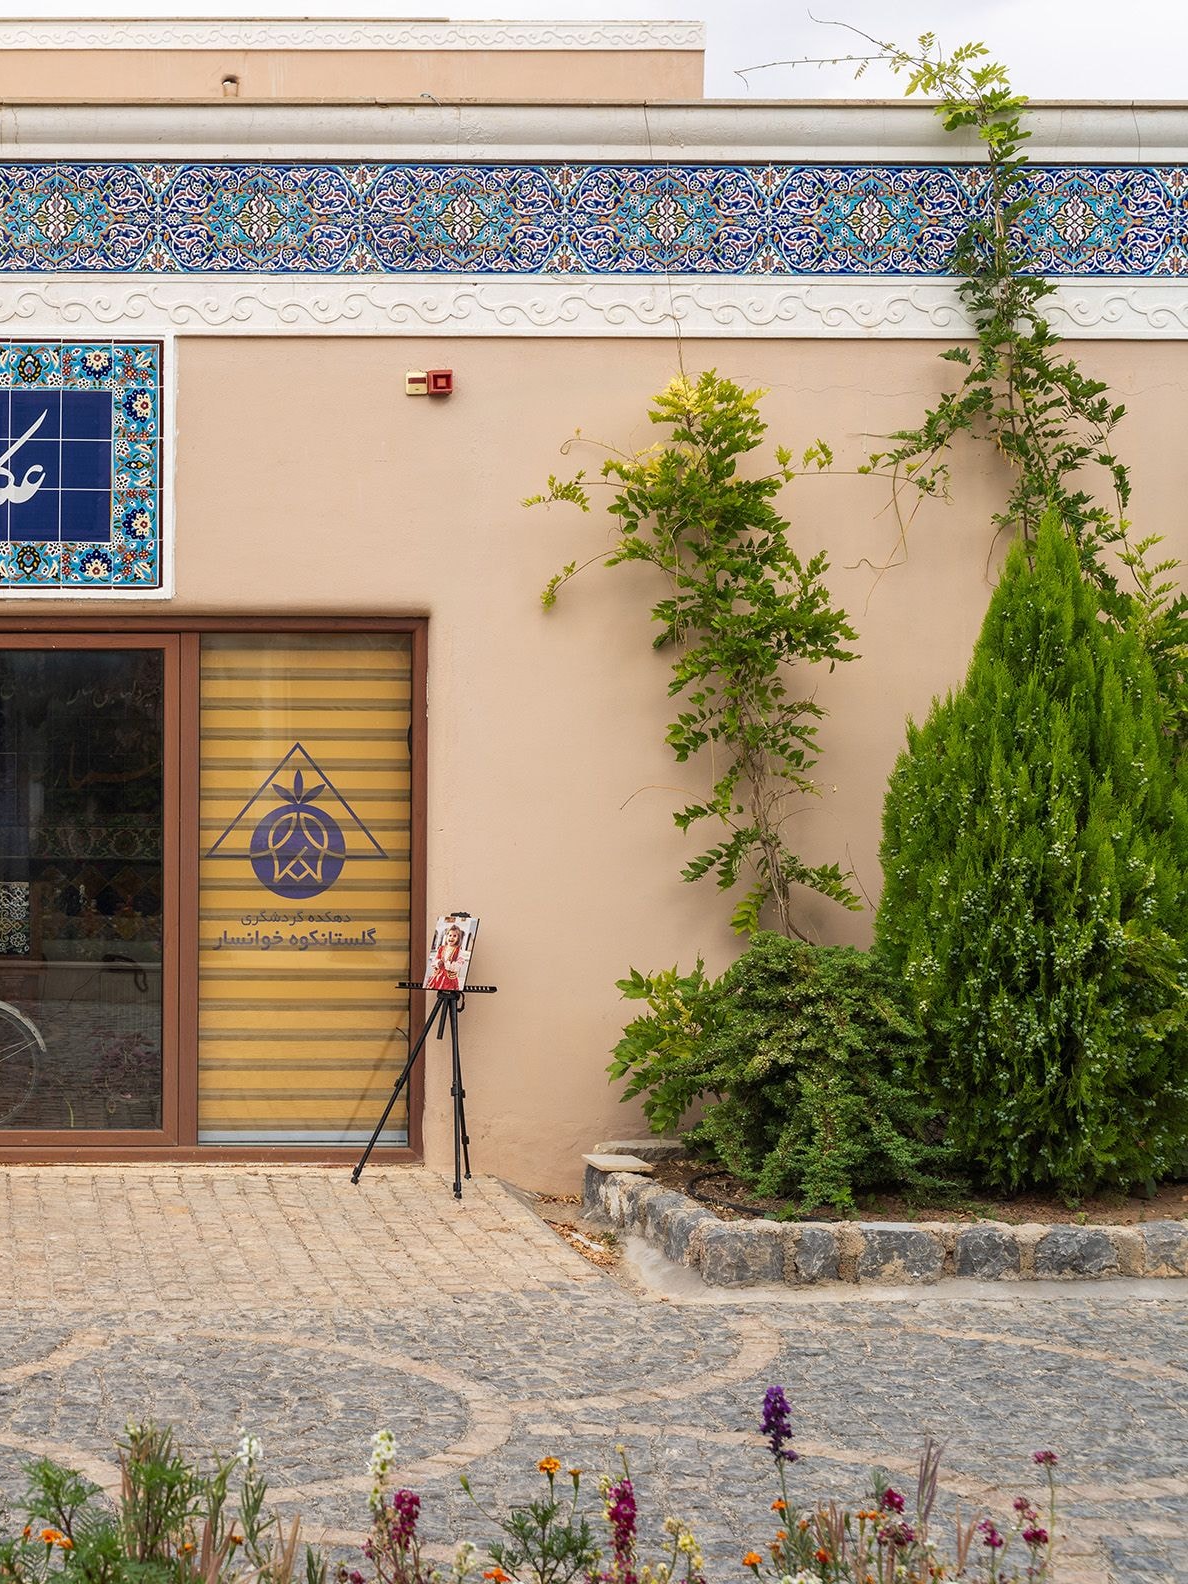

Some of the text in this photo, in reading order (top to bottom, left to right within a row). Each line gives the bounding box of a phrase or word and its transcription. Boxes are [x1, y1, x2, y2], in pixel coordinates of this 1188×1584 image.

[308, 911, 352, 924] دهکده
[212, 927, 377, 951] گلستانکوه خوانسار
